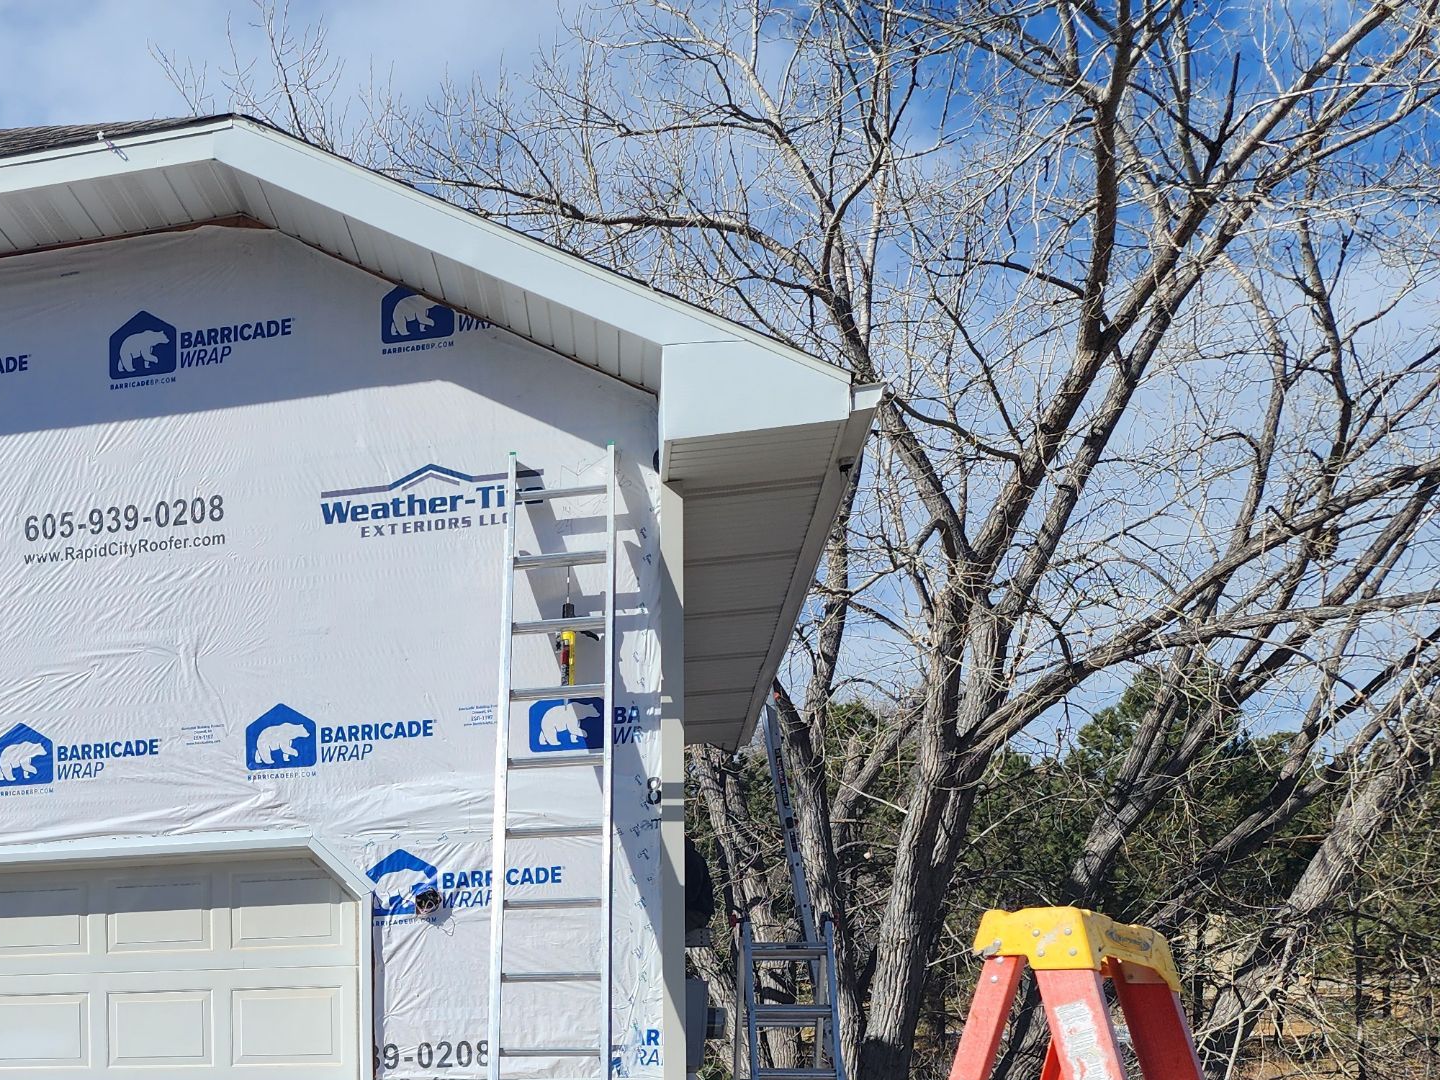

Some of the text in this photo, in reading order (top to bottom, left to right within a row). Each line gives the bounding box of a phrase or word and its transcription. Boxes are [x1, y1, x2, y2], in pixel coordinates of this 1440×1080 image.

[180, 318, 293, 349] BARRICADE
[180, 346, 232, 369] WRAP
[24, 495, 225, 542] 605-939-0208
[361, 516, 472, 538] EXTERIORS
[24, 531, 226, 565] www.RapidCityRoofer.com
[320, 720, 433, 744] BARRICADE
[57, 739, 159, 762] BARRICADE
[320, 743, 373, 764] WRAP
[57, 762, 105, 781] WRAP
